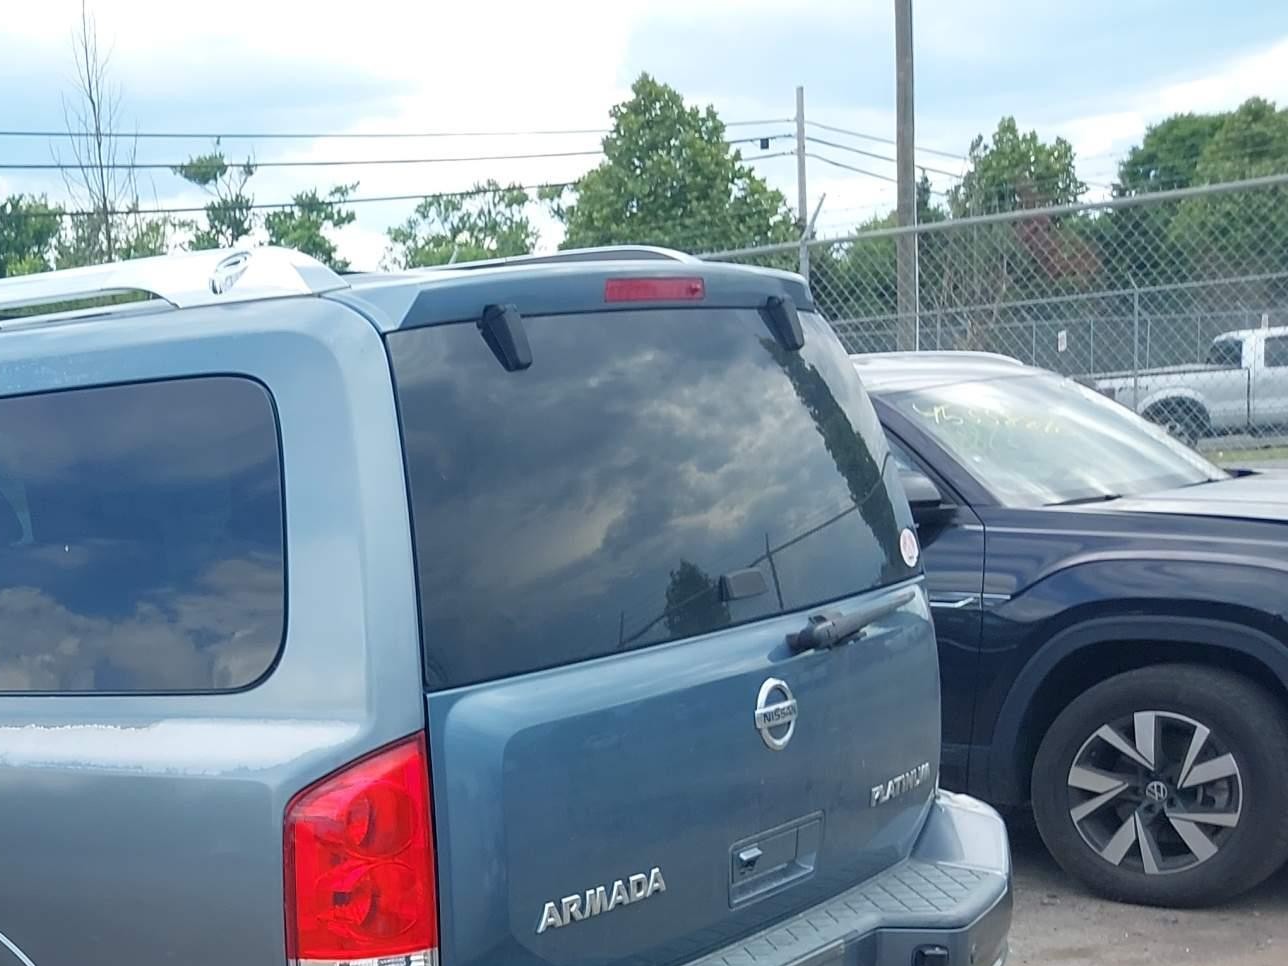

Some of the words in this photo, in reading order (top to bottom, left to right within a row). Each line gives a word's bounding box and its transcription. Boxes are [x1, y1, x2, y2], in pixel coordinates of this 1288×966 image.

[763, 704, 798, 724] NISSAN
[870, 762, 931, 807] PLATINUM
[536, 867, 667, 934] ARMADA
